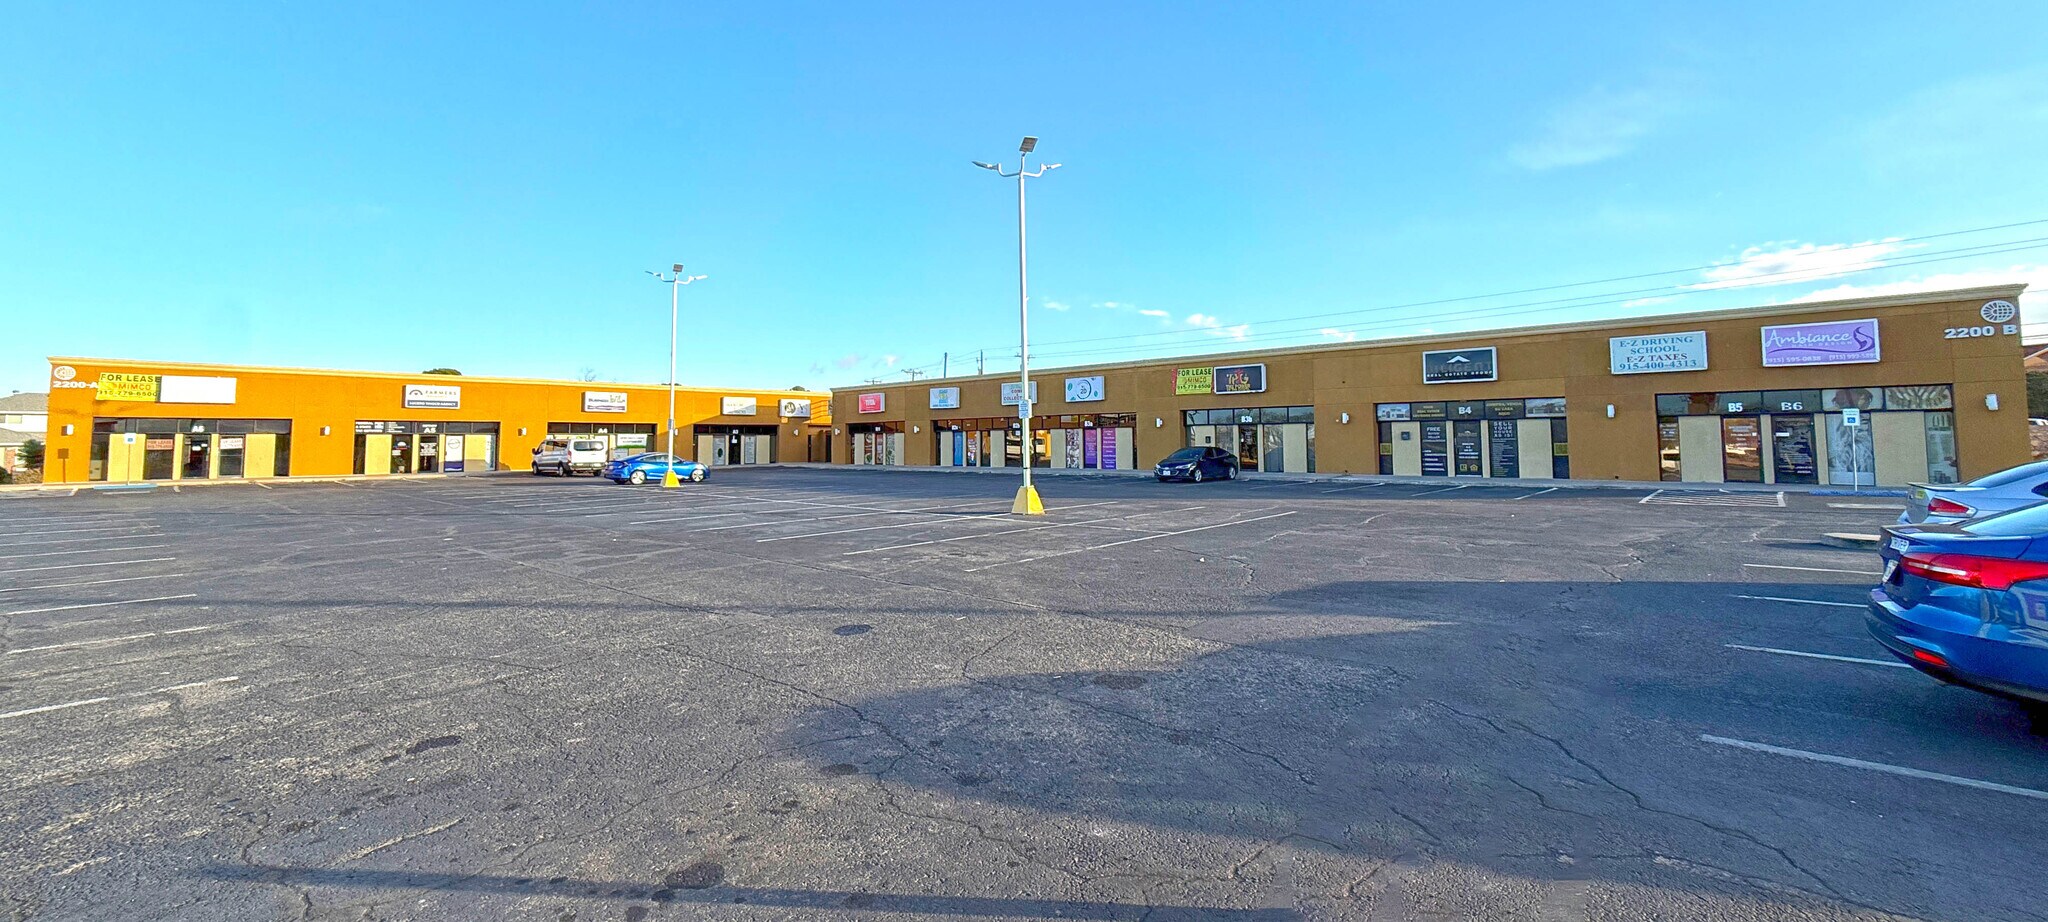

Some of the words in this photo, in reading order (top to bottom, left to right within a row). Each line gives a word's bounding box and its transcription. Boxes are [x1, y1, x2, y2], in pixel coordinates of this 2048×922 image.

[1944, 325, 1995, 339] 2200
[2002, 324, 2018, 335] B
[1620, 340, 1638, 348] E-Z
[1641, 335, 1693, 346] DRIVING
[1765, 329, 1852, 348] Ambiance
[1630, 345, 1680, 355] SCHOOL
[1626, 355, 1646, 363] E-Z
[1648, 352, 1688, 362] TAXES
[1619, 359, 1697, 371] 915-400-4313
[1178, 369, 1190, 377] FOR
[1191, 367, 1212, 376] LEASE
[101, 373, 123, 382] FOR
[126, 374, 162, 383] LEASE
[1458, 406, 1472, 415] B4
[1728, 402, 1743, 412] B5
[1781, 401, 1803, 411] B6
